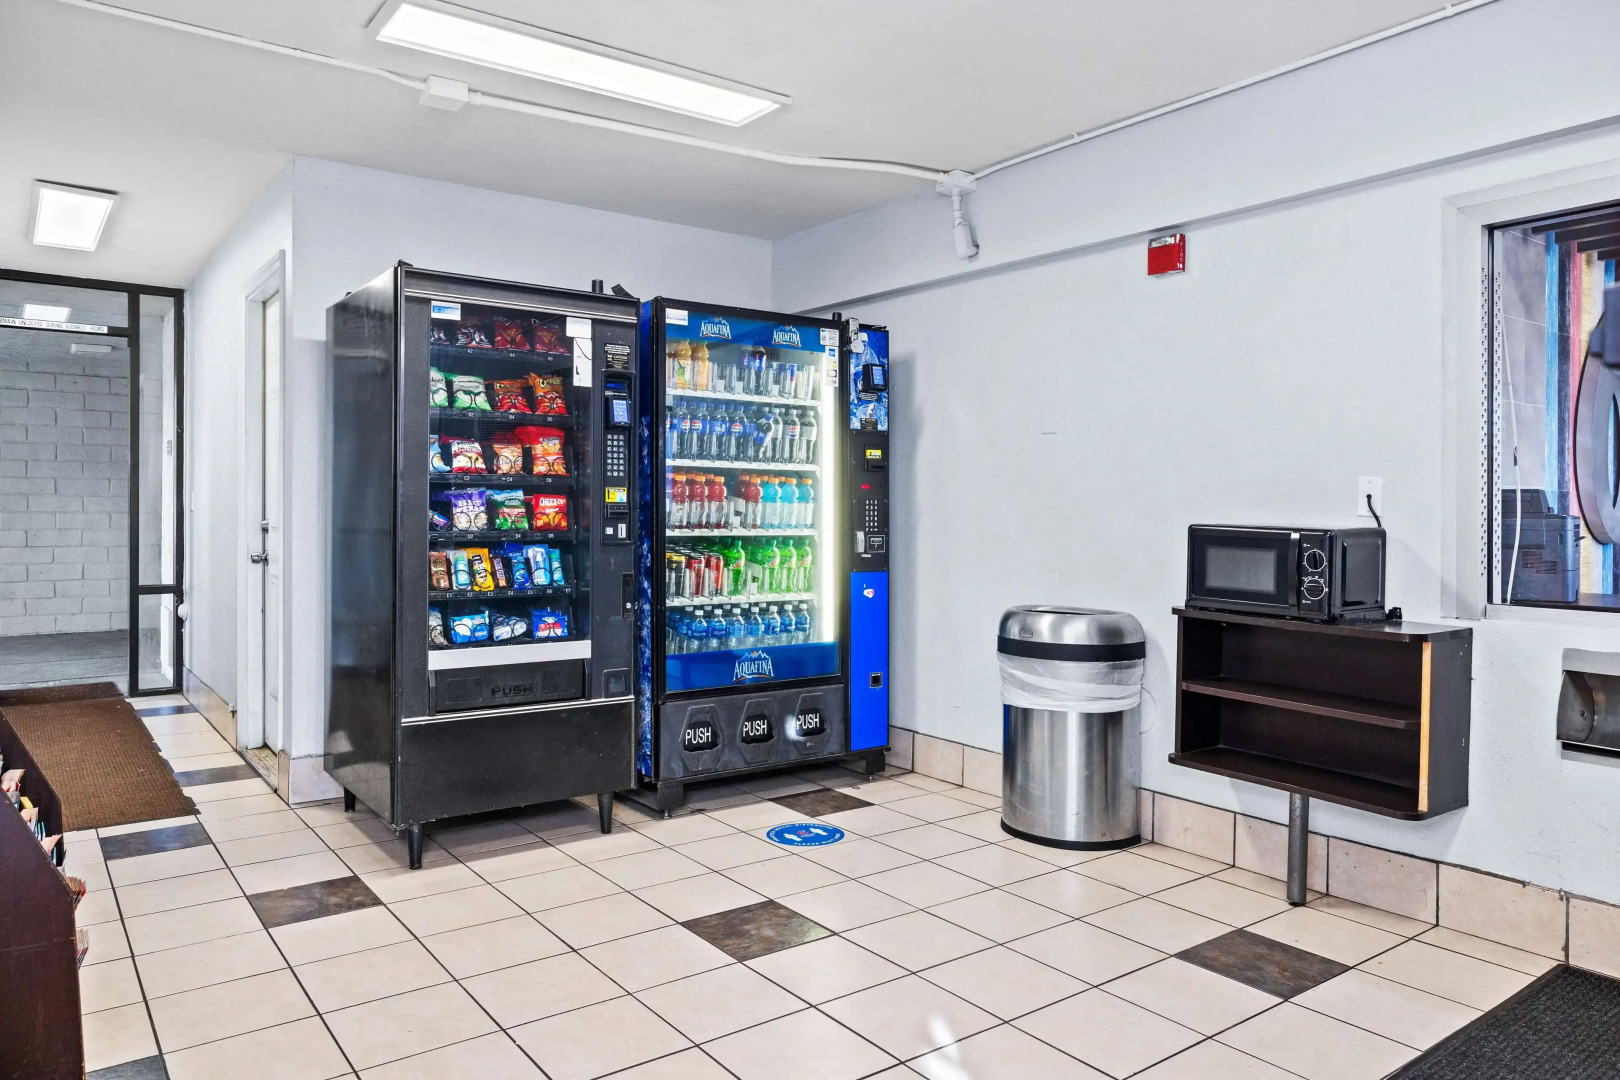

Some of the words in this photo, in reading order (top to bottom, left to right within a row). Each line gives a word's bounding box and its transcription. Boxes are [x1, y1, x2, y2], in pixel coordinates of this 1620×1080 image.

[46, 322, 63, 330] DURING
[700, 320, 732, 340] AQUAFINA
[772, 329, 801, 347] AQUAFINA
[732, 660, 775, 681] AQUAFINA
[492, 685, 532, 697] PUSH
[742, 719, 768, 738] PUSH
[796, 712, 820, 731] PUSH
[685, 726, 712, 745] PUSH
